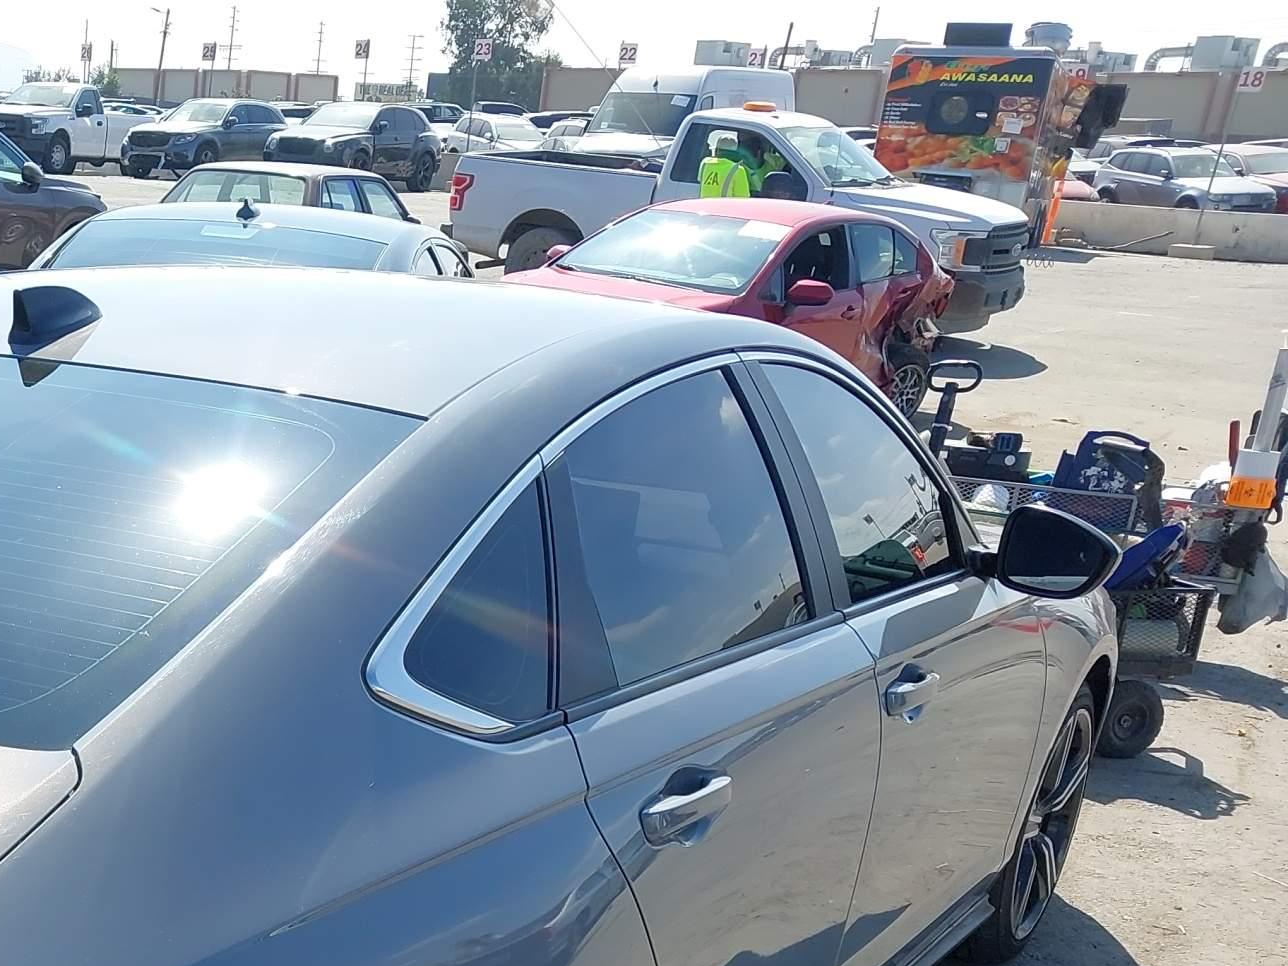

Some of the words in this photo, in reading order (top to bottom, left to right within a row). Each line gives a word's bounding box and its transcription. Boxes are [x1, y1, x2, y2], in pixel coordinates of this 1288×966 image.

[355, 43, 370, 56] 24
[476, 42, 491, 56] 23
[619, 47, 637, 61] 22
[749, 52, 764, 66] 21
[940, 72, 1033, 83] AWASAANA
[1239, 71, 1264, 88] 18
